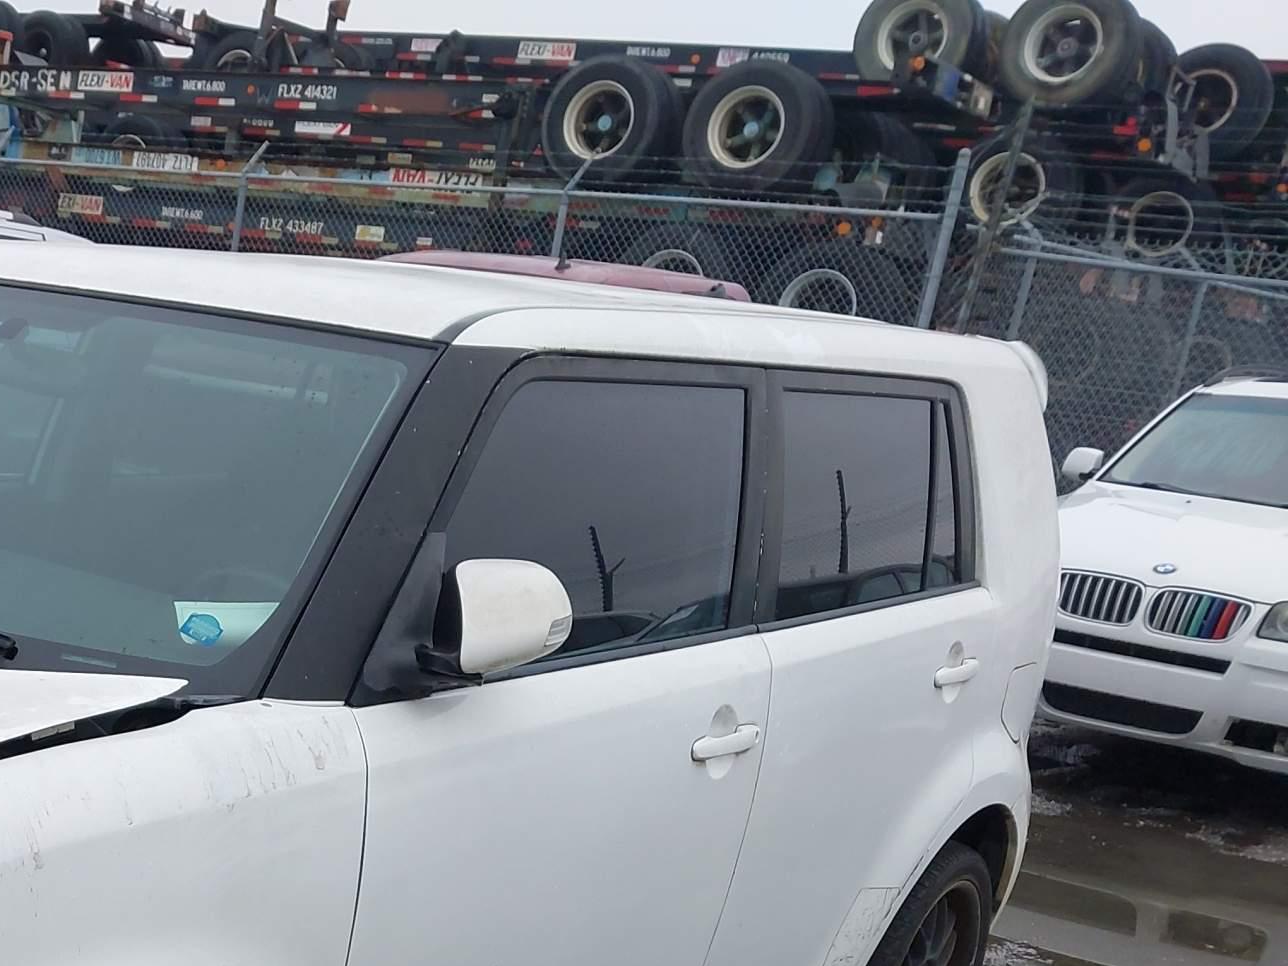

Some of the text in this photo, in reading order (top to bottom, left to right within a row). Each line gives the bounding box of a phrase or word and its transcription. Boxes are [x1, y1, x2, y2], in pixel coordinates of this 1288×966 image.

[518, 42, 574, 58] FLEXI-VAN
[79, 73, 131, 89] FLEXI-VAN
[278, 84, 337, 100] FLXZ 414321
[260, 217, 282, 231] FLXZ
